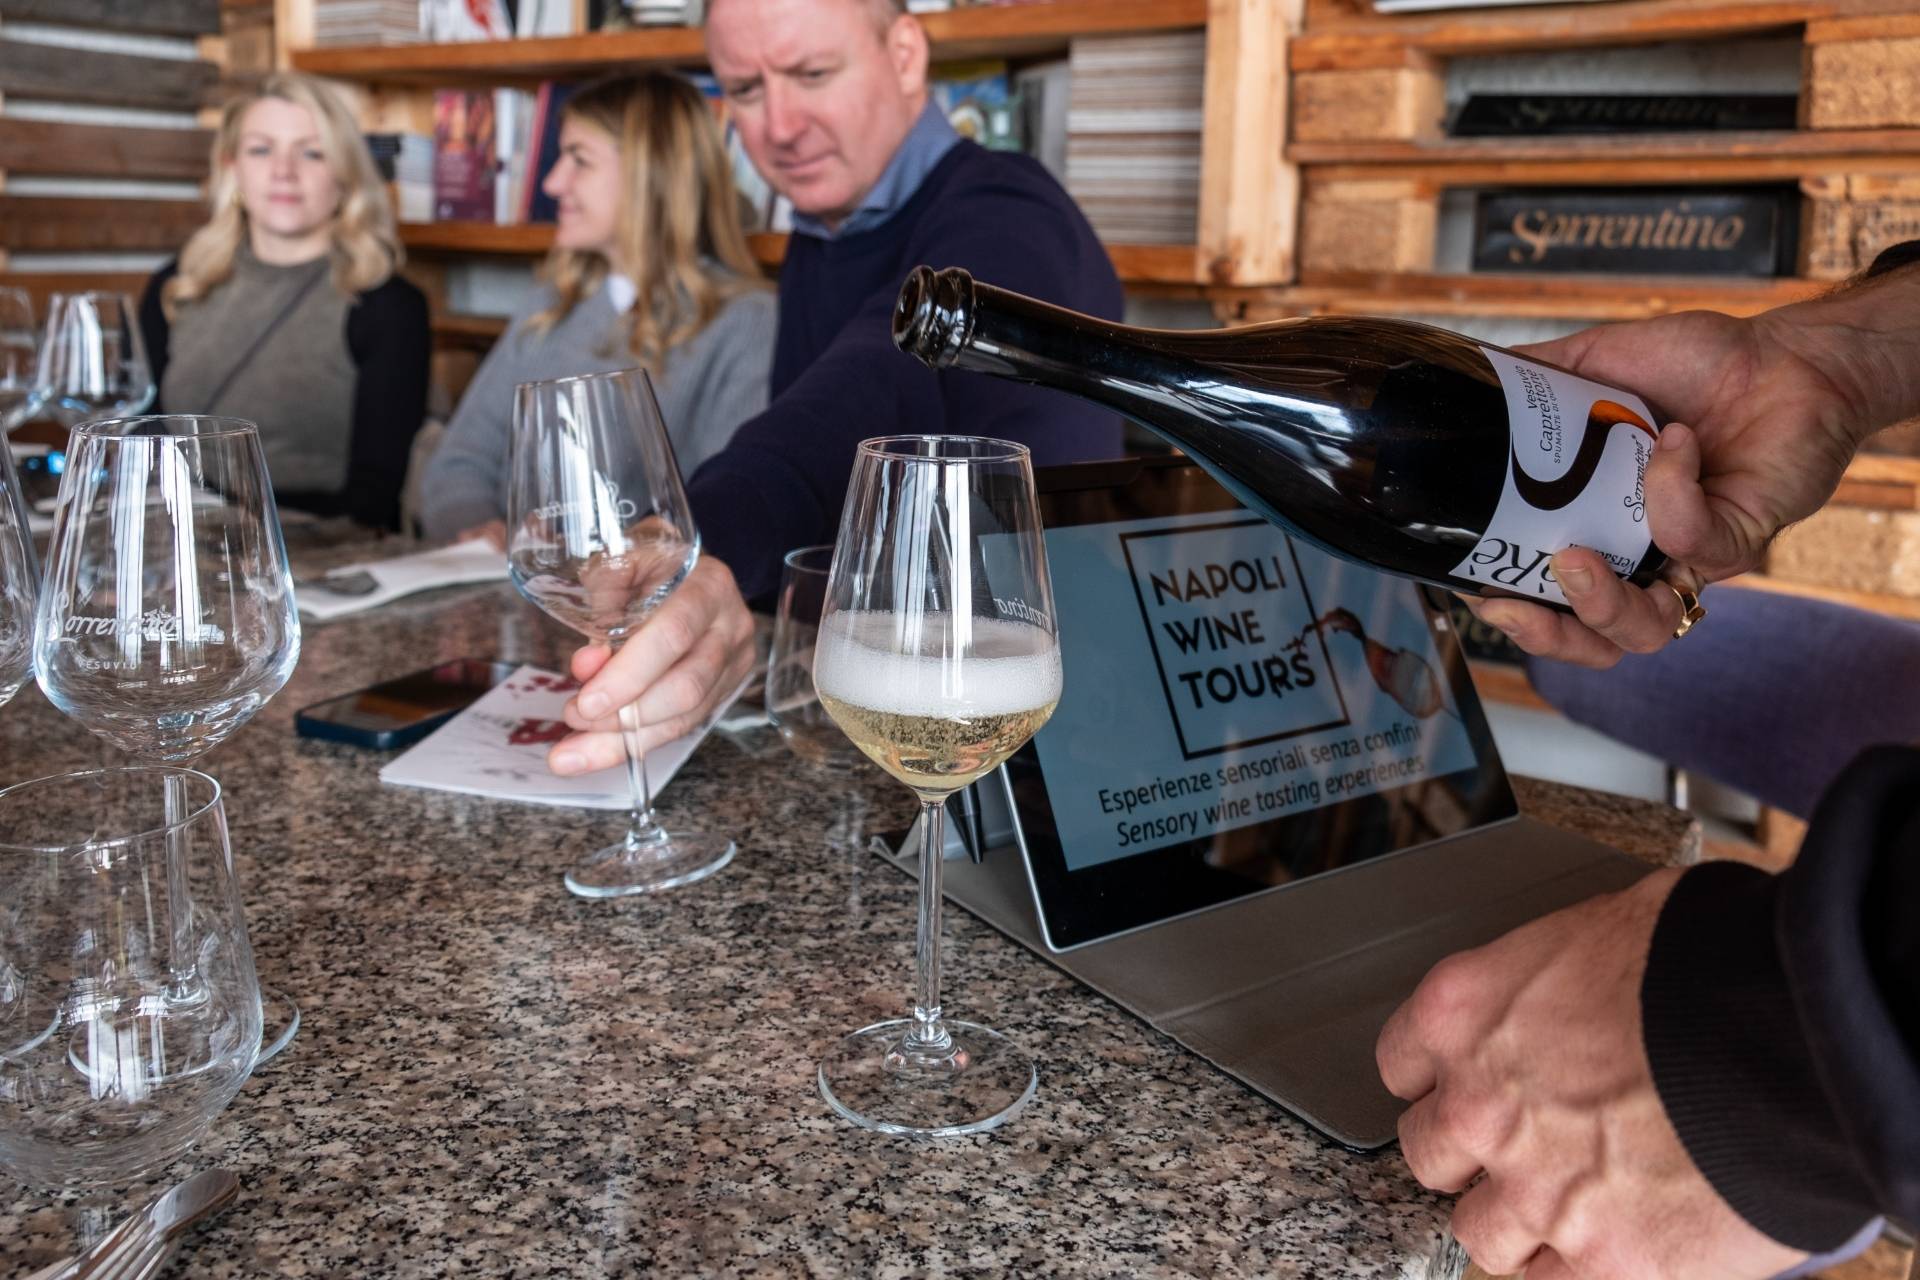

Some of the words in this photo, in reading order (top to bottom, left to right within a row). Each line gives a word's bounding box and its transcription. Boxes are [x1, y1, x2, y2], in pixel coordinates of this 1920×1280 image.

[1511, 201, 1745, 263] Sorrentino
[1514, 365, 1538, 409] Vesuvio
[1526, 369, 1554, 452] Caprettone
[1553, 414, 1562, 464] SPUMANTE
[1624, 439, 1645, 522] Sorrentino
[1150, 556, 1286, 606] NAPOLI
[1163, 610, 1265, 655] WINE
[1178, 653, 1316, 708] TOURS
[1099, 768, 1212, 813] Esperienze
[1217, 746, 1307, 786] sensoriali
[1310, 736, 1361, 764] senza
[1364, 719, 1421, 753] confini
[1117, 809, 1199, 847] Sensory
[1204, 796, 1250, 824] wine
[1254, 775, 1322, 812] tasting
[1324, 753, 1426, 796] experiences
